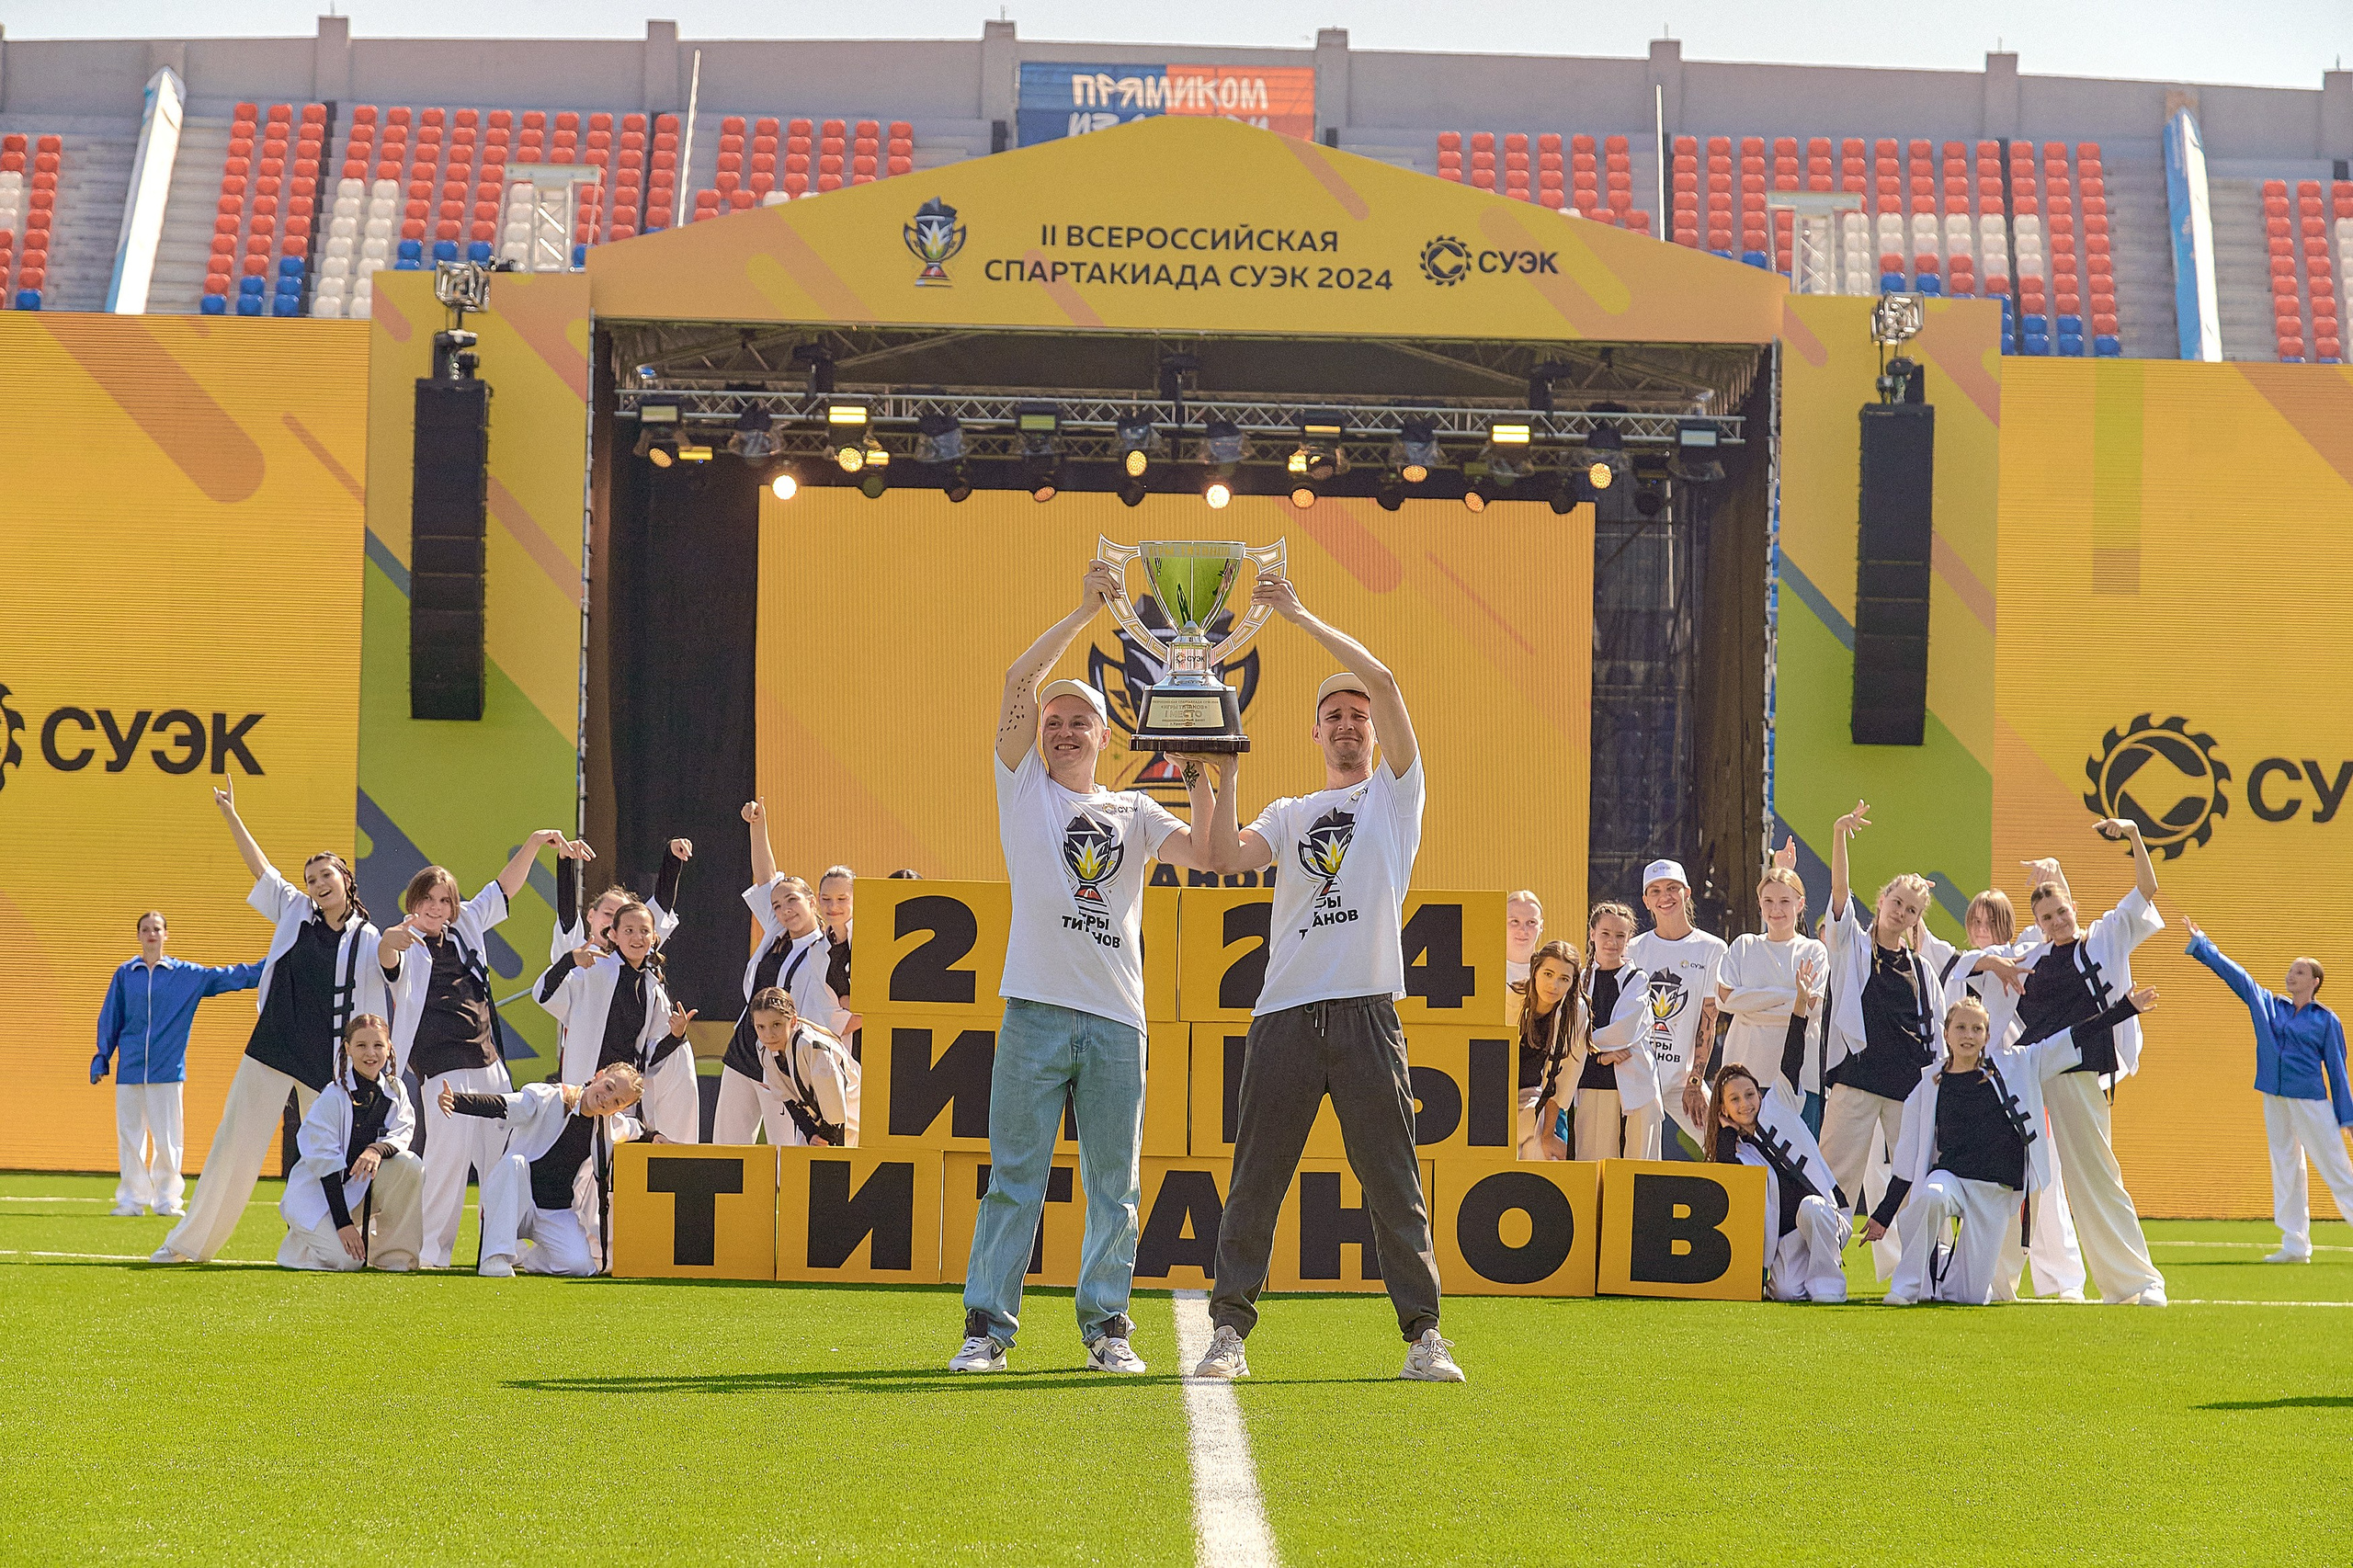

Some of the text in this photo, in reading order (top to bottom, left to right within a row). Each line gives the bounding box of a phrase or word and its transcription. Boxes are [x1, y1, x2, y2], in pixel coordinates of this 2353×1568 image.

[1071, 73, 1269, 110] ПРЯМИКОМ
[1067, 224, 1338, 252] ВСЕРОССИЙСКАЯ
[984, 259, 1393, 290] СПАРТАКИАДА СУЭК 2024
[1478, 250, 1559, 275] СУЭК
[41, 707, 265, 776] СУЭК
[2246, 757, 2353, 824] СУ
